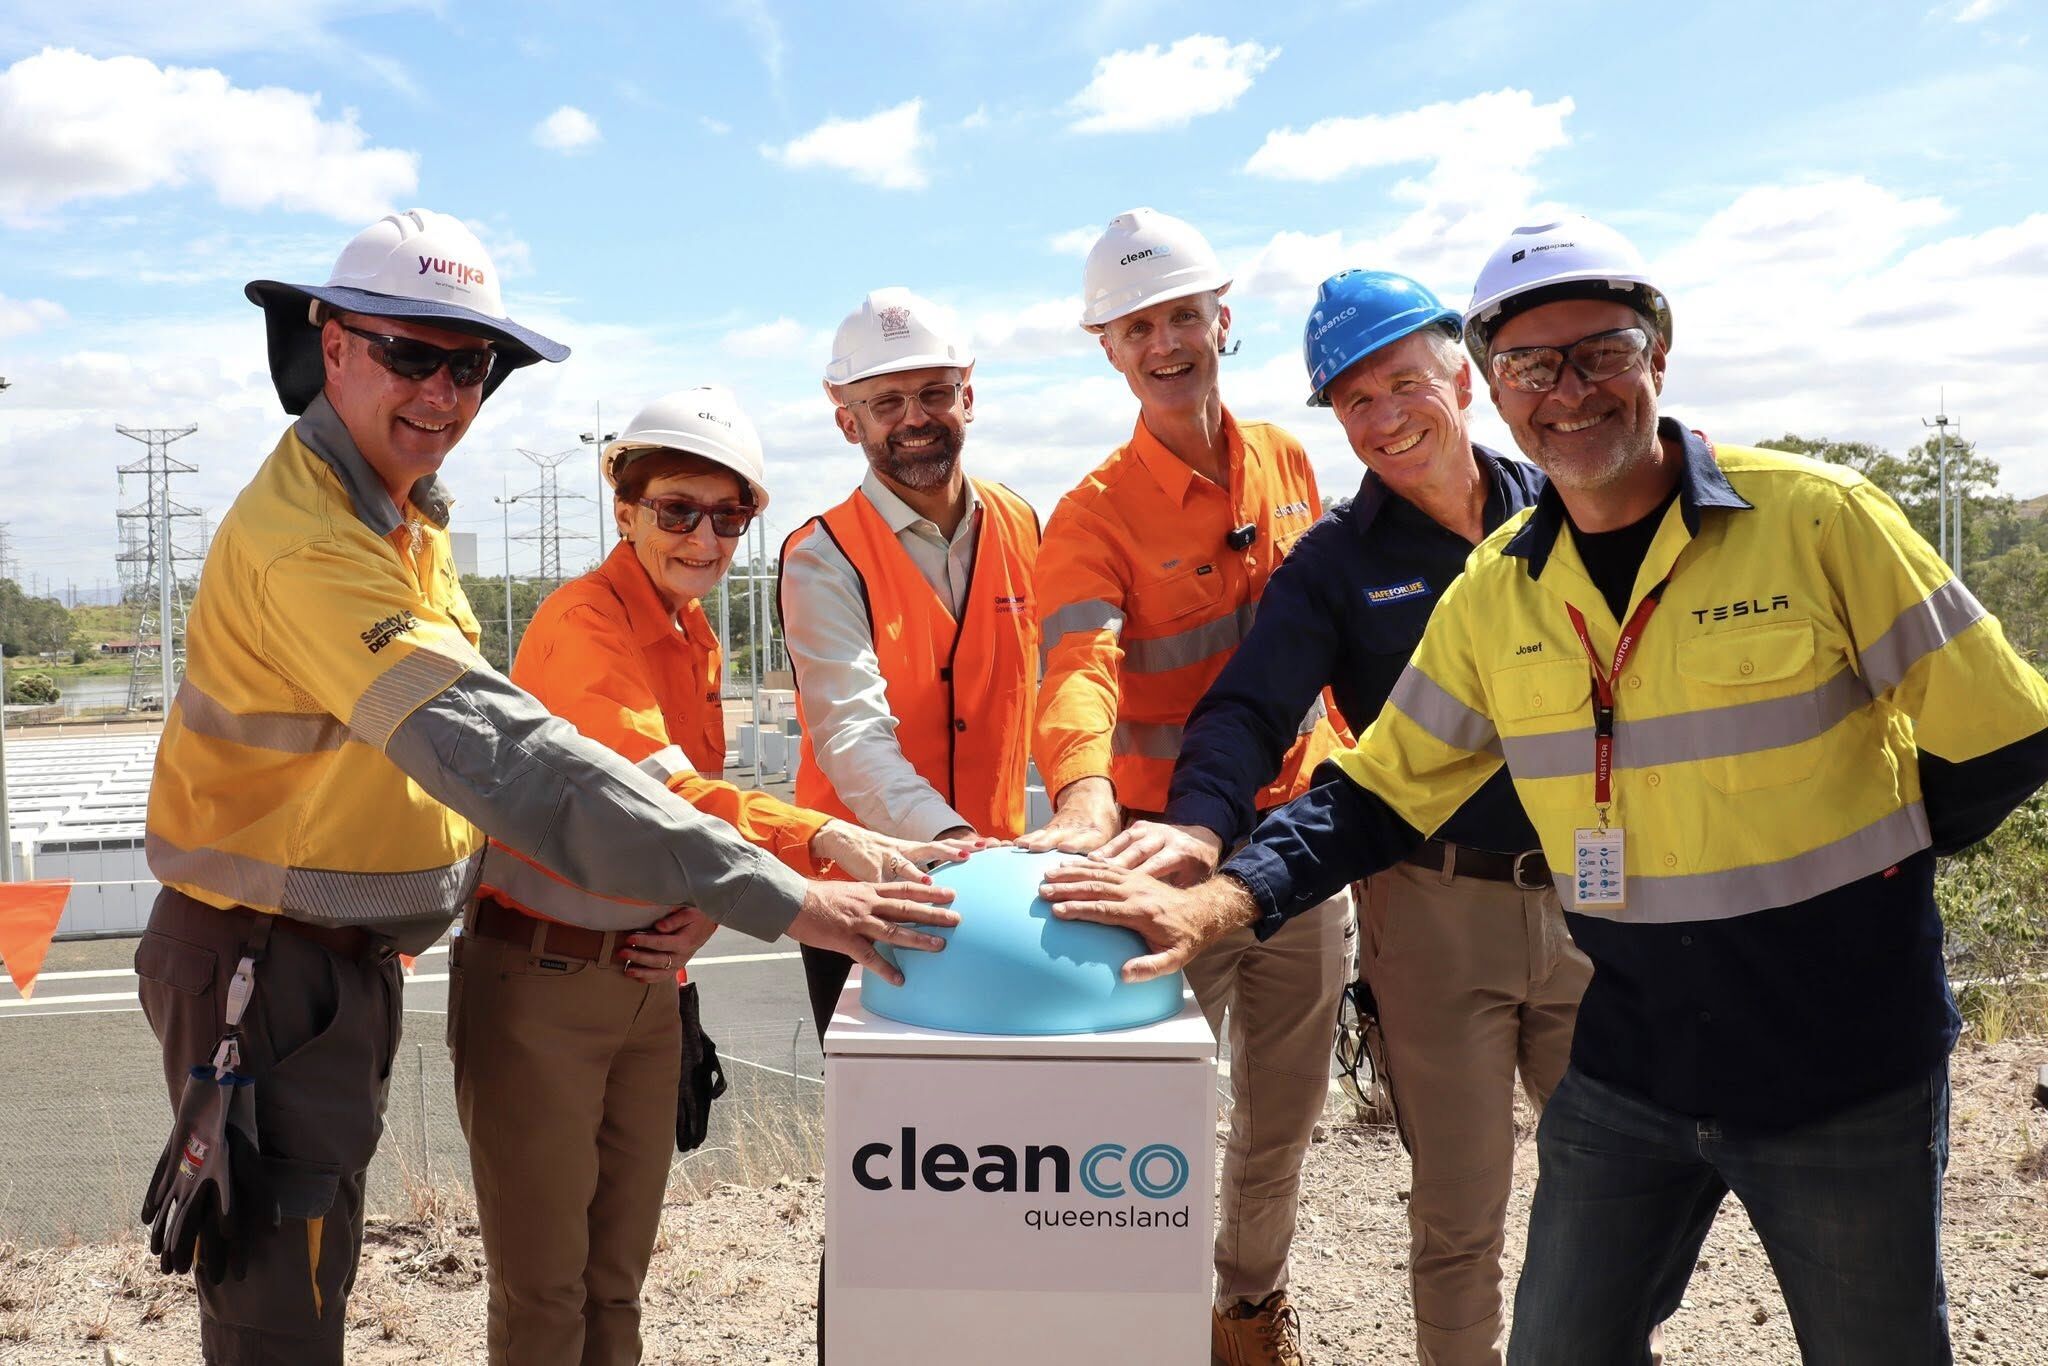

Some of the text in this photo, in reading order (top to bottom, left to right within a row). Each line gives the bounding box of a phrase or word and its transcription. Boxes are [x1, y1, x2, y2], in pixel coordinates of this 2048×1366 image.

[1531, 243, 1575, 253] Megapack
[1314, 306, 1357, 340] cleanco
[1691, 595, 1788, 624] TESLA
[360, 614, 401, 644] Safety
[1516, 642, 1542, 655] Josef
[1613, 636, 1632, 672] VISITOR
[1600, 744, 1608, 781] VISITOR
[1024, 1205, 1189, 1229] queensland
